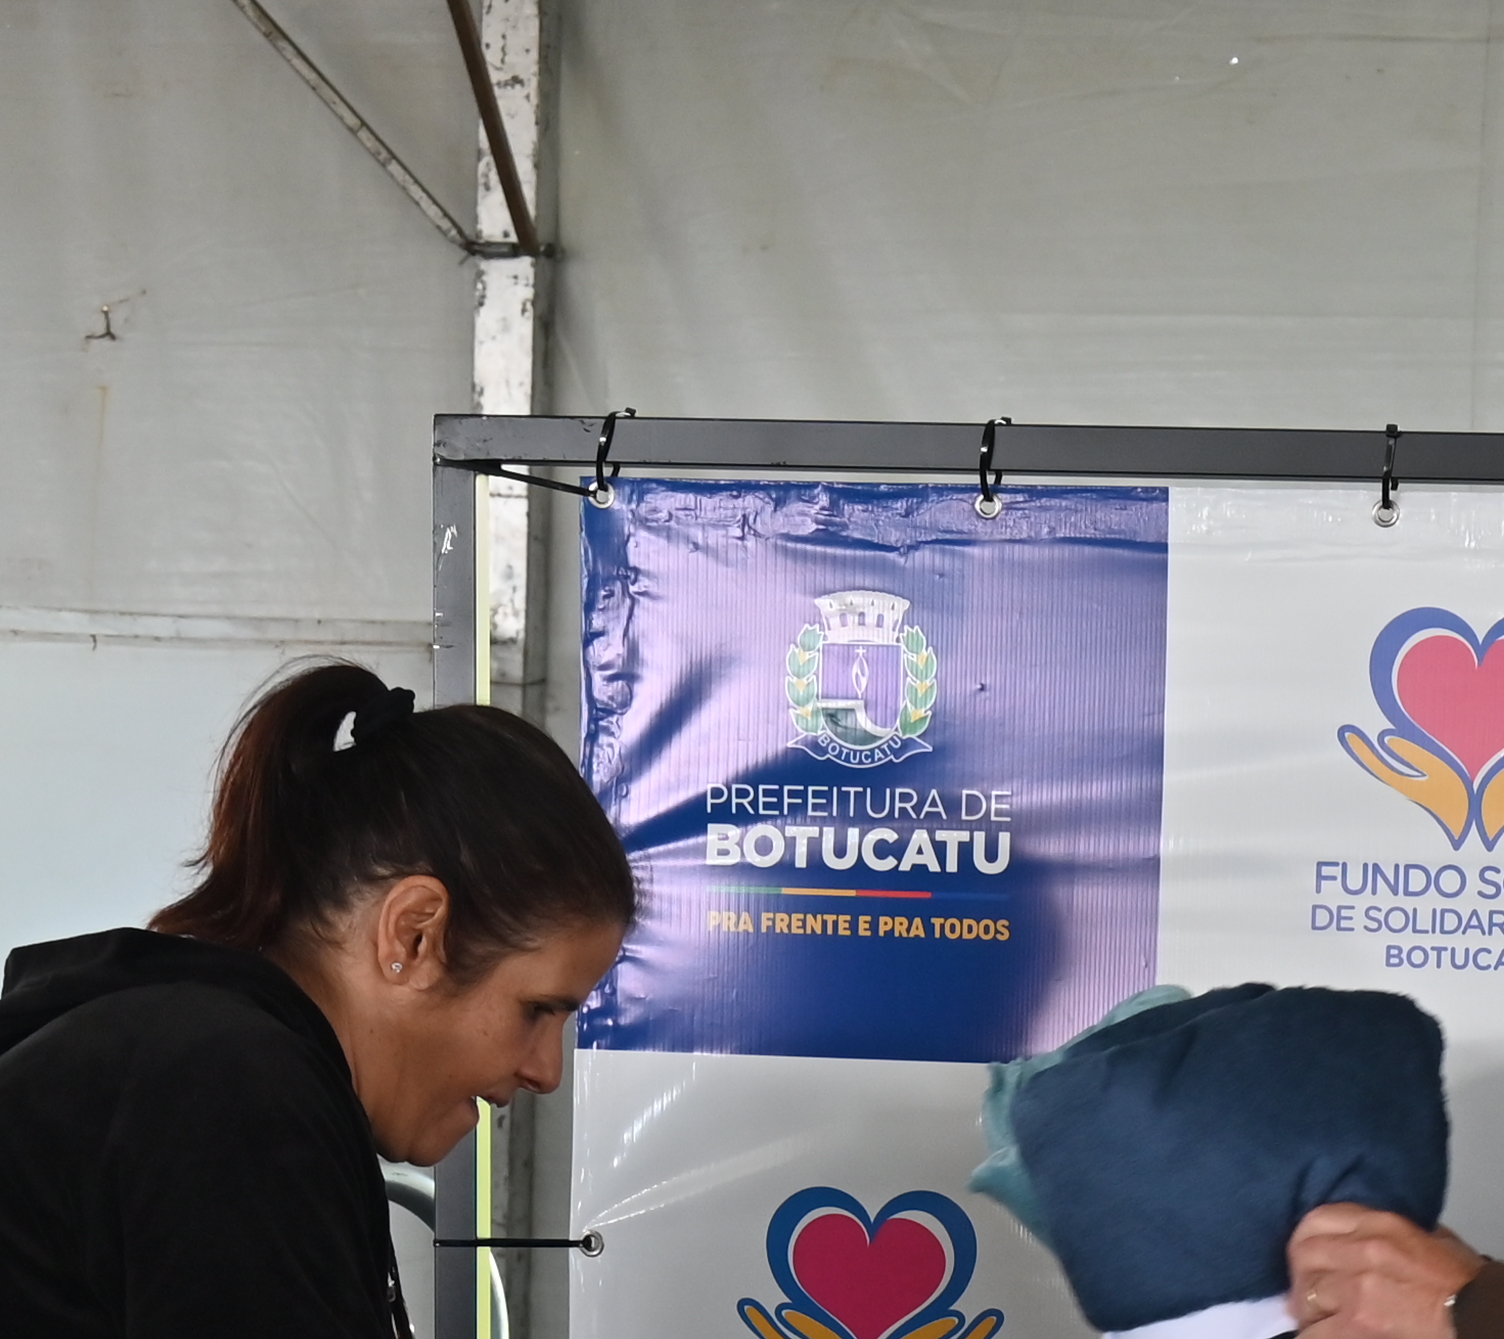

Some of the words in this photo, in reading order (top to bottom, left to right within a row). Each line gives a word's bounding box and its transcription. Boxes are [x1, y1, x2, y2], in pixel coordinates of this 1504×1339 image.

[816, 733, 903, 765] BOTUCATU
[705, 783, 947, 820] PREFEITURA
[960, 789, 1013, 822] DE
[704, 822, 1011, 876] BOTUCATU
[1314, 860, 1468, 899] FUNDO
[706, 910, 754, 934] PRA
[760, 912, 851, 936] FRENTE
[858, 915, 872, 936] E
[878, 916, 926, 938] PRA
[931, 917, 1011, 942] TODOS
[1310, 903, 1356, 933] DE
